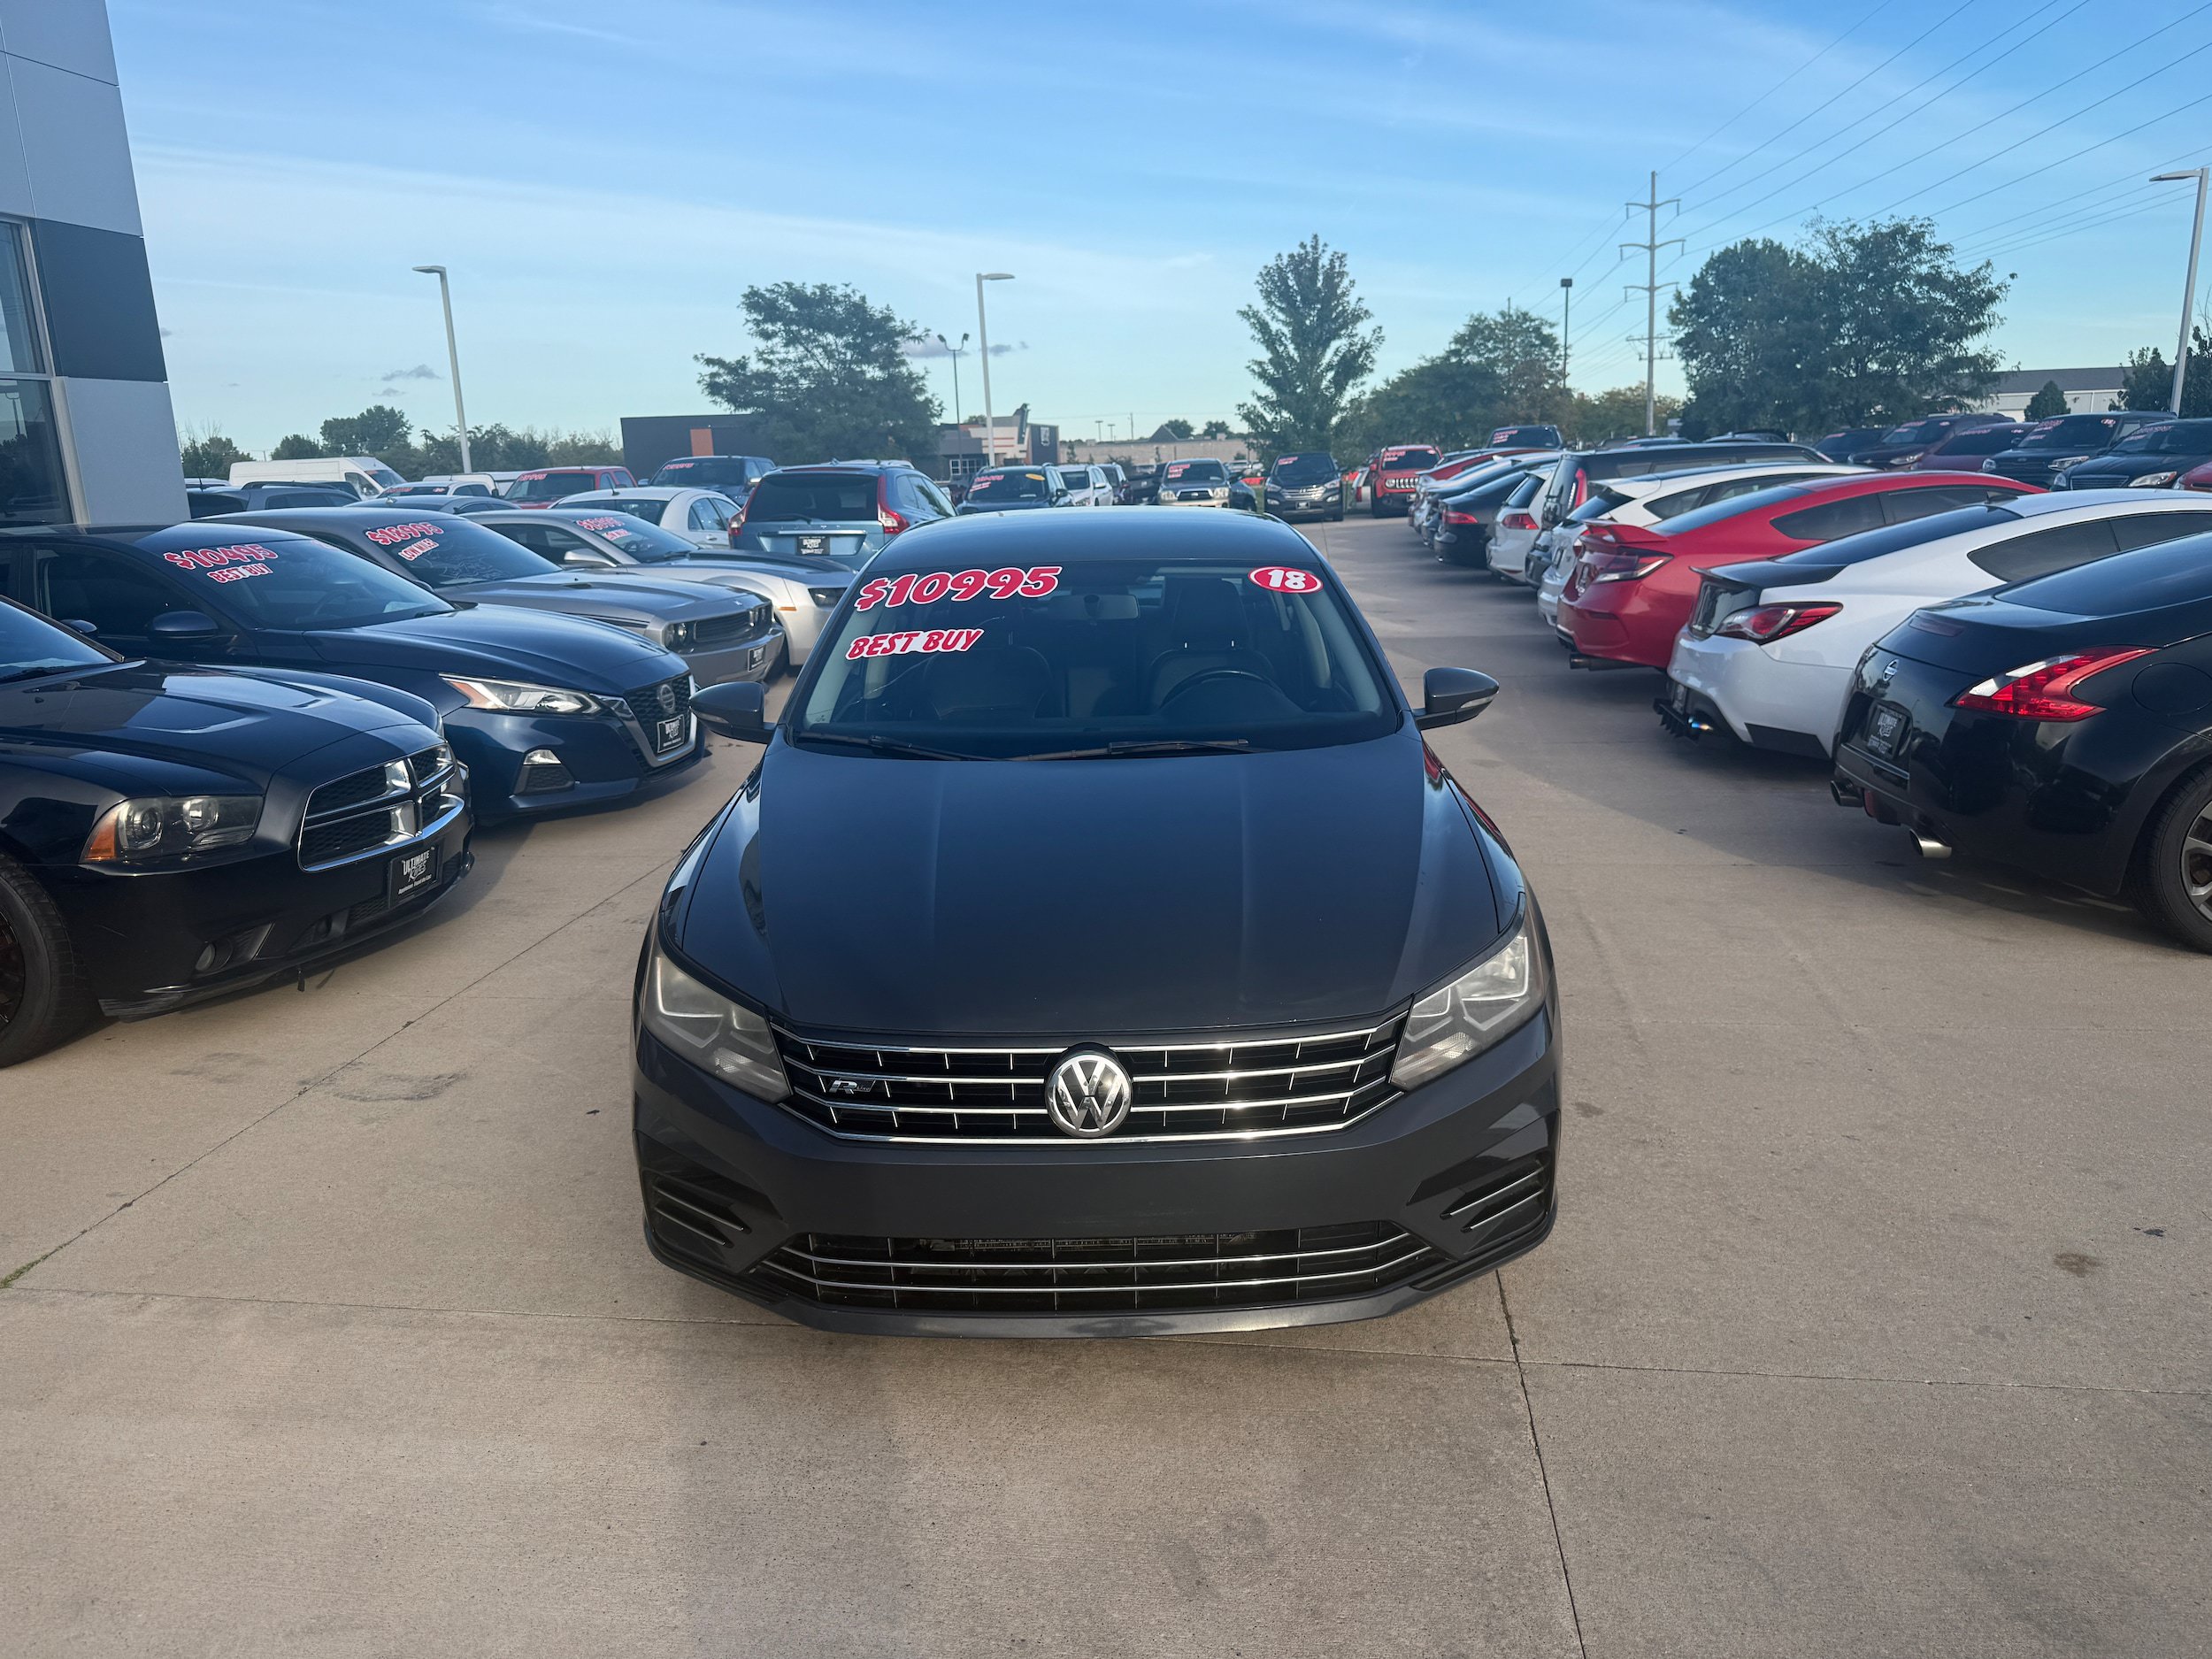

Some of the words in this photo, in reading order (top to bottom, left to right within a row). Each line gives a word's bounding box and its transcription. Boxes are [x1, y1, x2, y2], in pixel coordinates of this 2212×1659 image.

[163, 543, 278, 570] $10495
[207, 566, 246, 583] BEST
[242, 563, 273, 576] BUY
[1267, 569, 1306, 589] 18
[855, 565, 1063, 611] $10995
[846, 631, 921, 660] BEST
[922, 628, 984, 652] BUY
[401, 850, 430, 876] ULTIMATE
